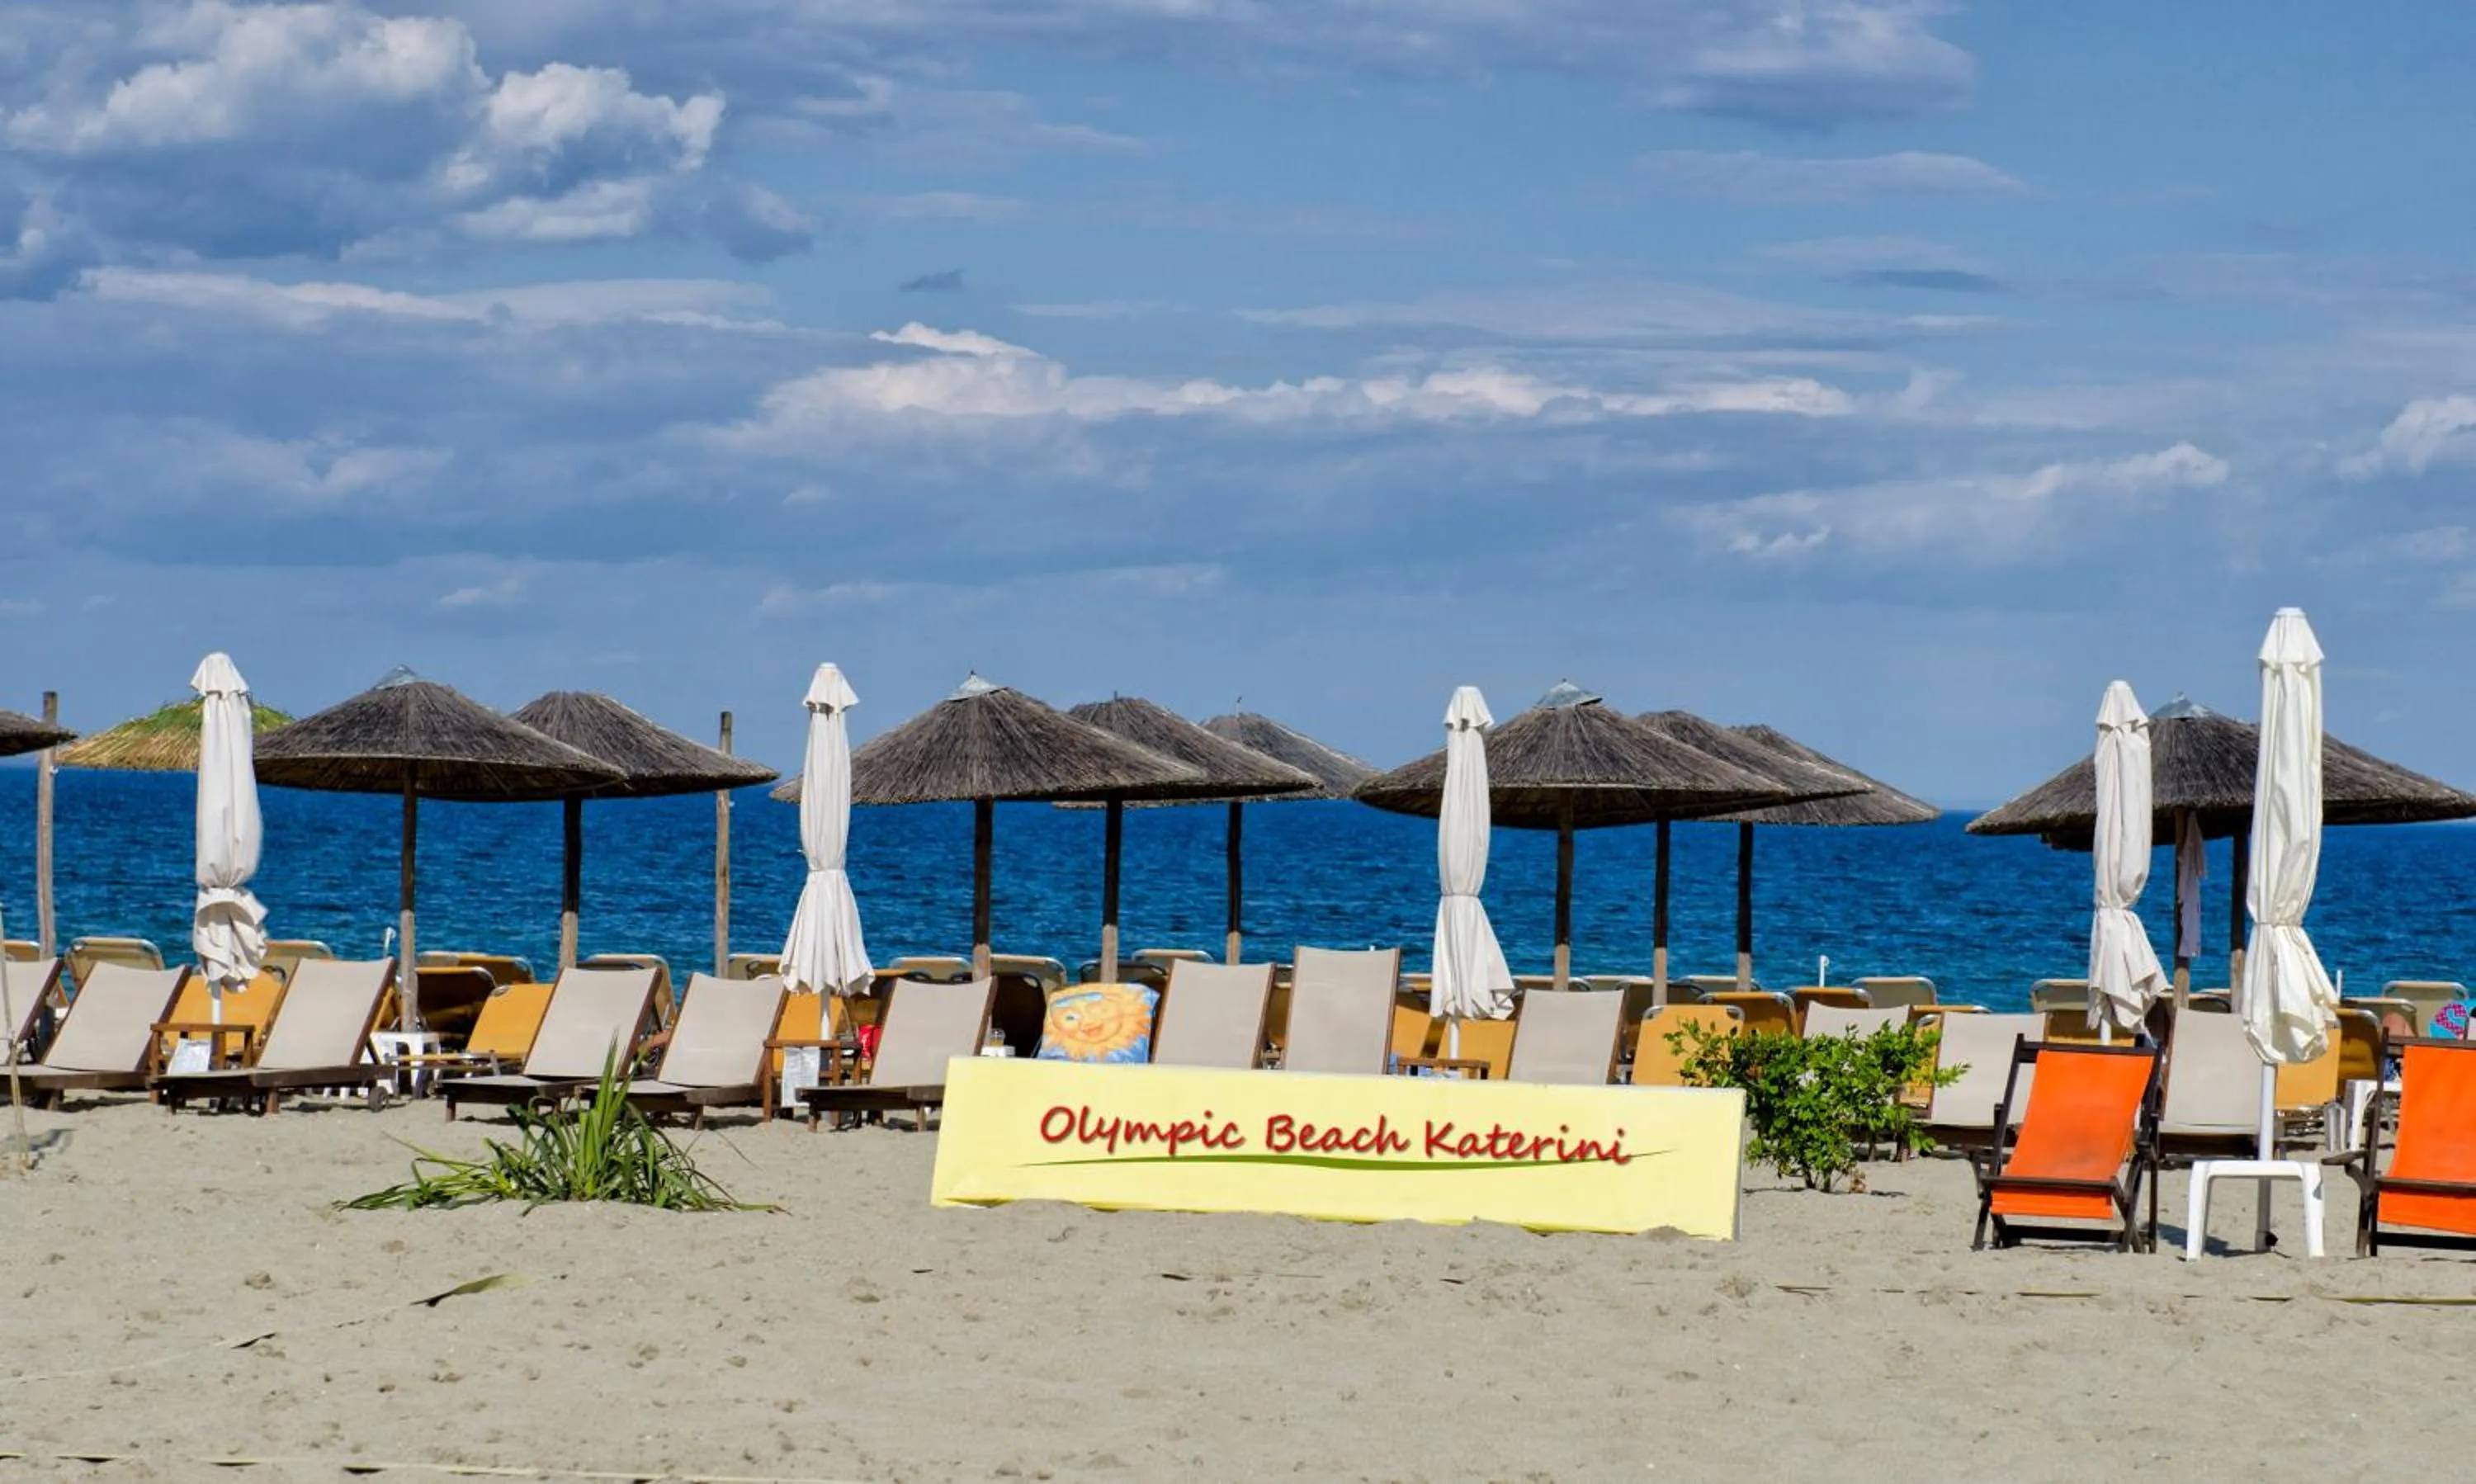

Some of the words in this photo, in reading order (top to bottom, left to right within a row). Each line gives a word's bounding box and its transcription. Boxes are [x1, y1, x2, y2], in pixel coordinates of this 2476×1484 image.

[1040, 1105, 1245, 1159] Olympic
[1265, 1114, 1410, 1154] Beach
[1425, 1121, 1630, 1164] Katerini
